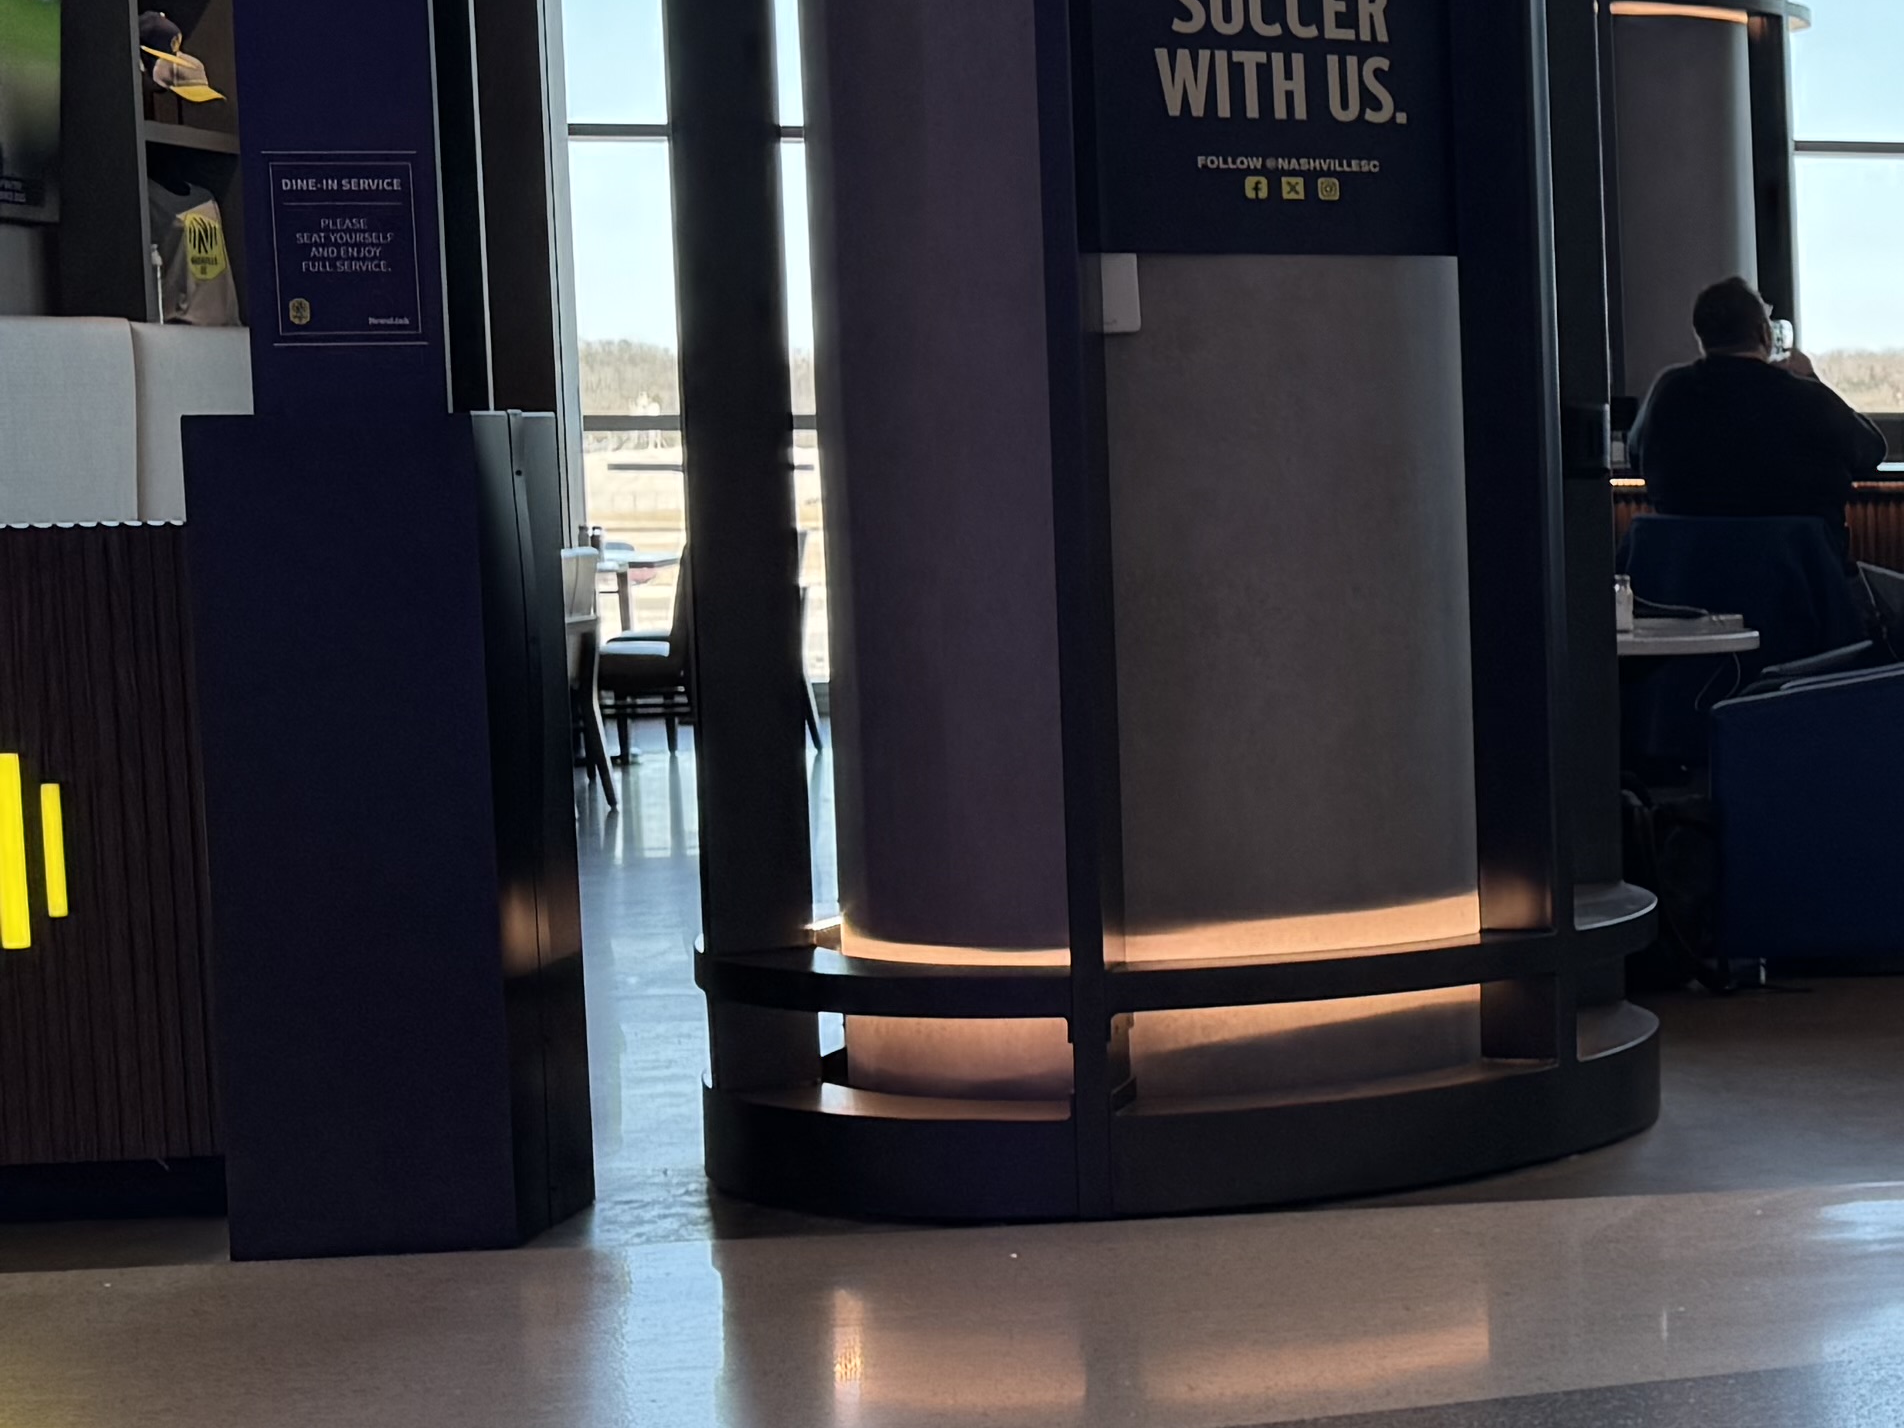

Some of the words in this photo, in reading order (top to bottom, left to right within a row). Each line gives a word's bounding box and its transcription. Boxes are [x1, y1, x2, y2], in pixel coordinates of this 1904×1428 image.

[1153, 47, 1308, 121] WITH
[1326, 53, 1408, 125] US.
[1196, 155, 1263, 170] FOLLOW
[1265, 156, 1380, 173] @NASHVILLESC
[281, 177, 338, 191] DINE-IN
[341, 177, 402, 191] SERVICE
[320, 217, 368, 230] PLEASE
[295, 232, 325, 244] SEAT
[329, 232, 393, 244] YOURSELF
[310, 246, 338, 258] AND
[340, 246, 382, 258] ENJOY
[301, 260, 332, 272] FULL
[336, 260, 392, 272] SERVICE.
